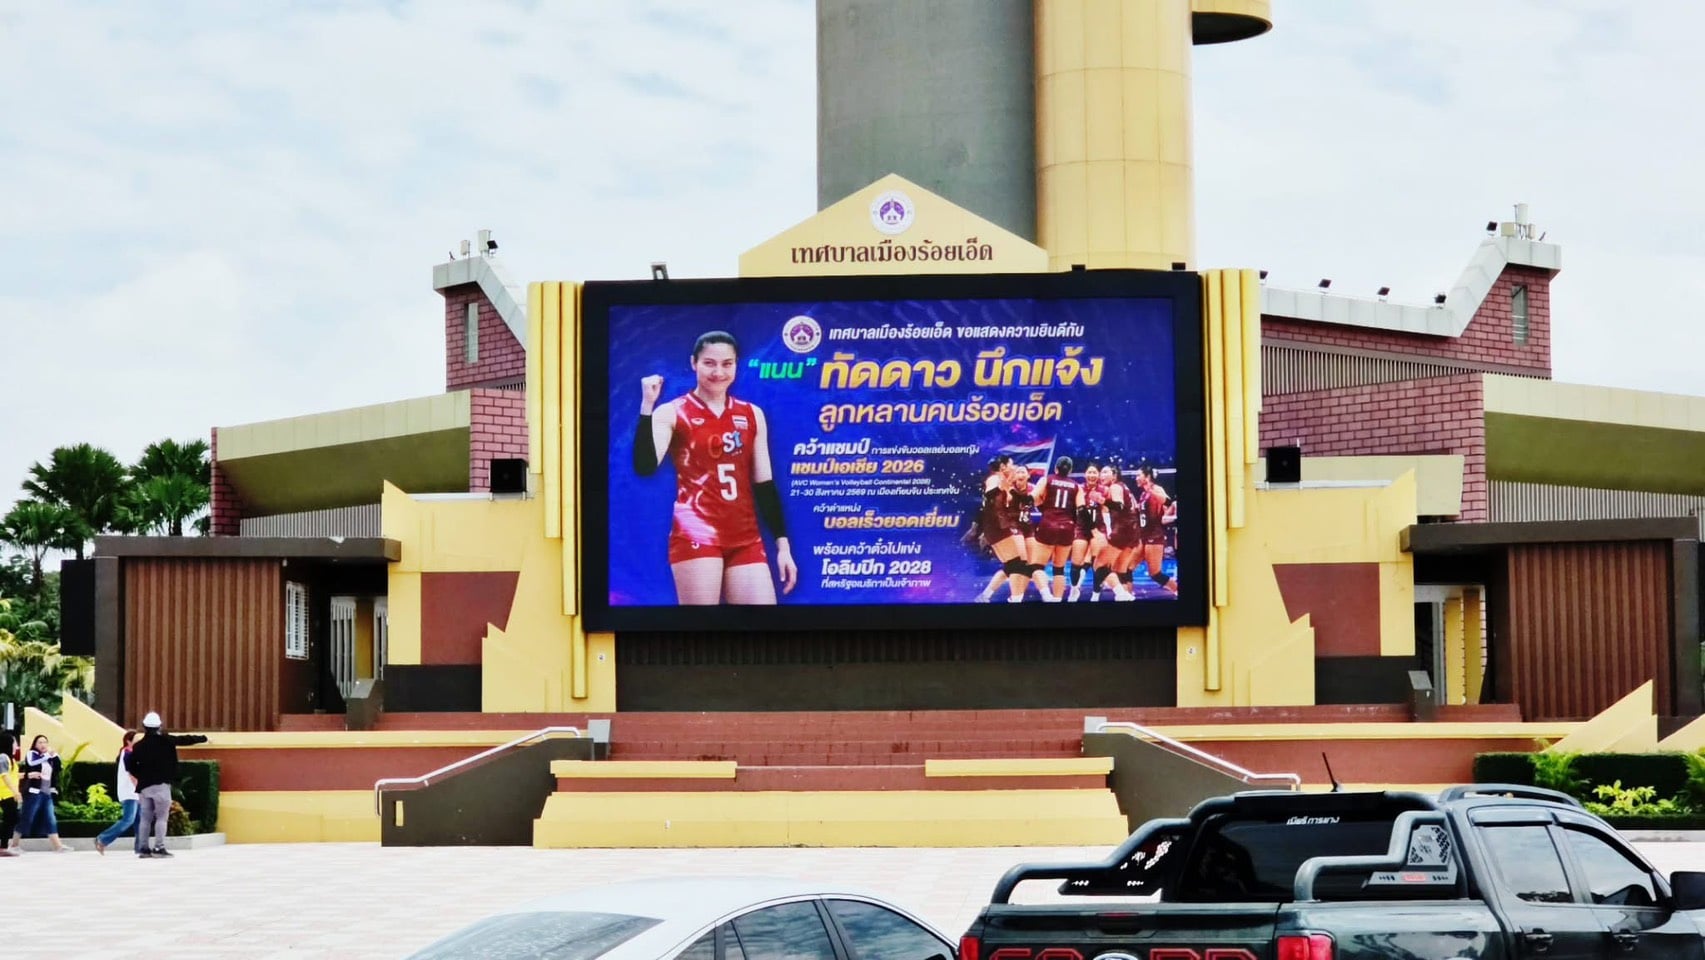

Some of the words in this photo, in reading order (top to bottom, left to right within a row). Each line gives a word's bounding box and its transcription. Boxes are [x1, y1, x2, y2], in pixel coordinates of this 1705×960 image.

[791, 237, 993, 264] เทศบาลเมืองร้อยเอ็ด
[829, 321, 952, 340] เทศบาลเมืองร้อยเอ็ด
[956, 322, 1085, 338] ขอแสดงความยินดีกับ
[820, 352, 961, 389] ทัดดาว
[973, 345, 1104, 386] นึกแจ้ง
[818, 393, 1062, 432] ลูกหลานคนร้อยเอ็ด
[793, 438, 871, 456] คว้าแชมป์
[790, 458, 878, 475] แชมป์เอเชีย
[881, 460, 924, 474] 2026
[717, 464, 738, 501] 5
[790, 489, 814, 497] 21-30
[1055, 489, 1068, 508] 11
[813, 503, 861, 512] คว้าตำแหน่ง
[824, 506, 959, 528] บอลเร็วยอดเยี่ยม
[813, 538, 921, 555] พร้อมคว้าตั๋วไปแข่ง
[821, 558, 885, 575] โอลิมปิก
[888, 560, 932, 574] 2028
